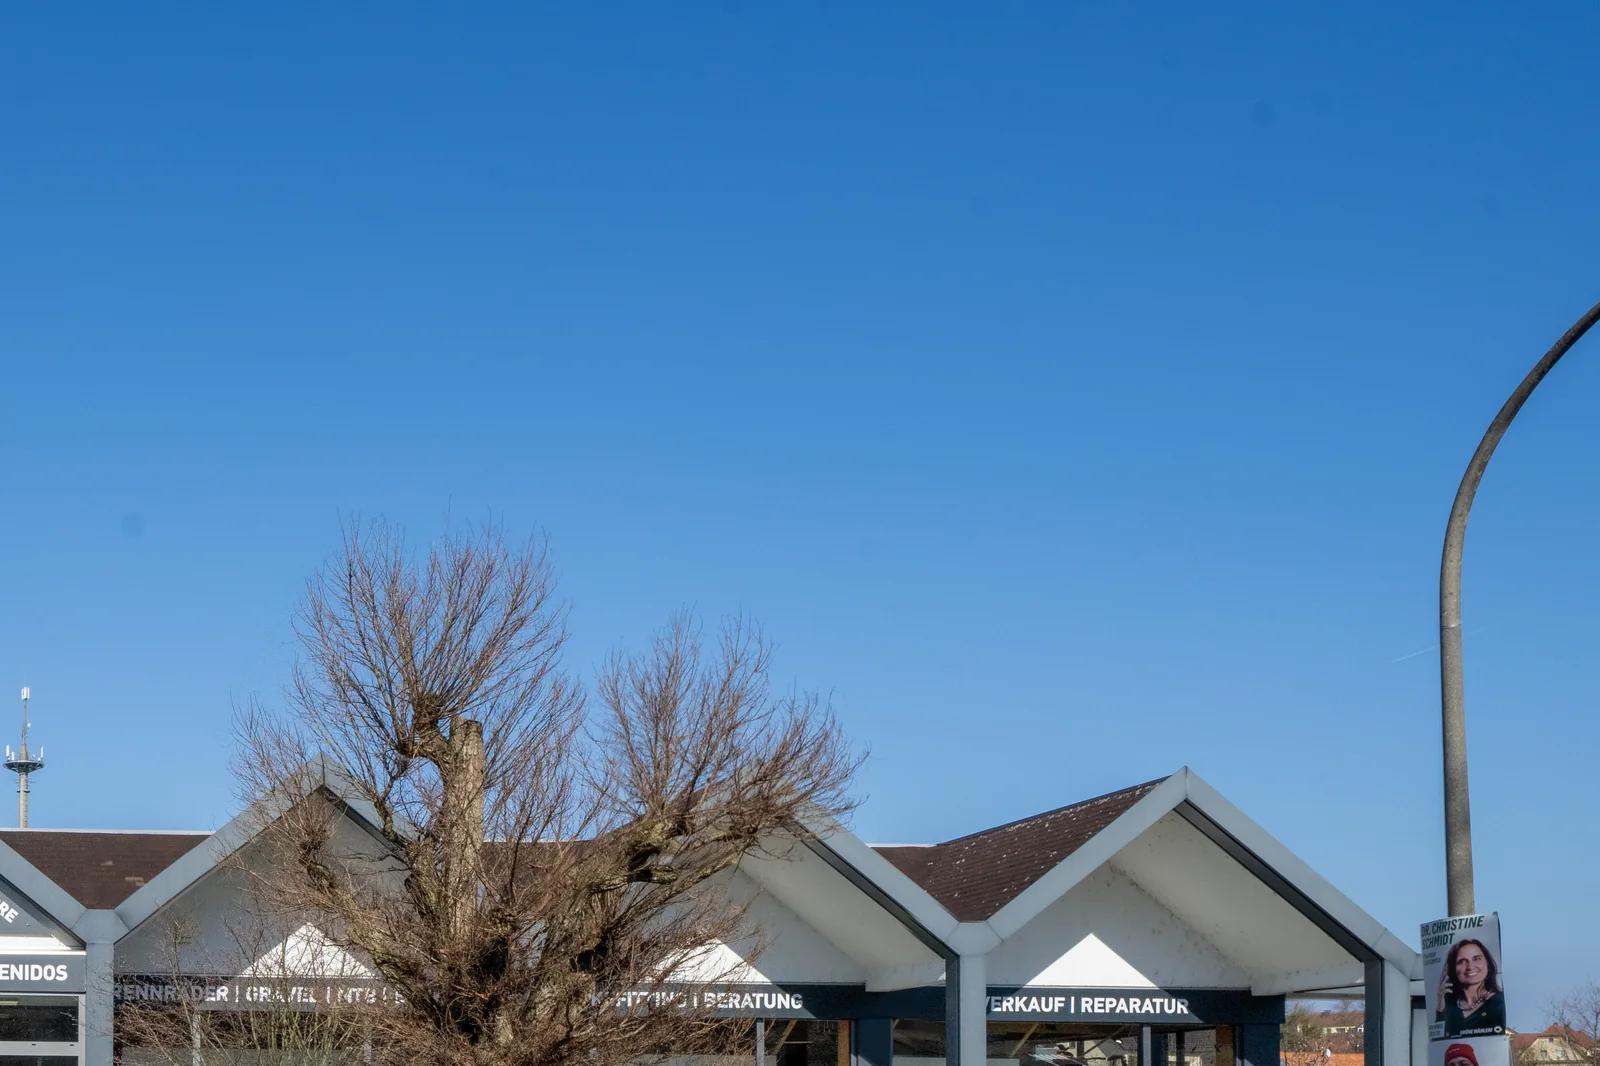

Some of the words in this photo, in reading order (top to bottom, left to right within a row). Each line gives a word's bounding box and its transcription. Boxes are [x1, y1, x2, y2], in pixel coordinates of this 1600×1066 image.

[1431, 916, 1485, 934] CHRISTINE
[1422, 933, 1456, 950] SCHMIDT
[703, 992, 804, 1009] BERATUNG
[1081, 997, 1189, 1015] REPARATUR
